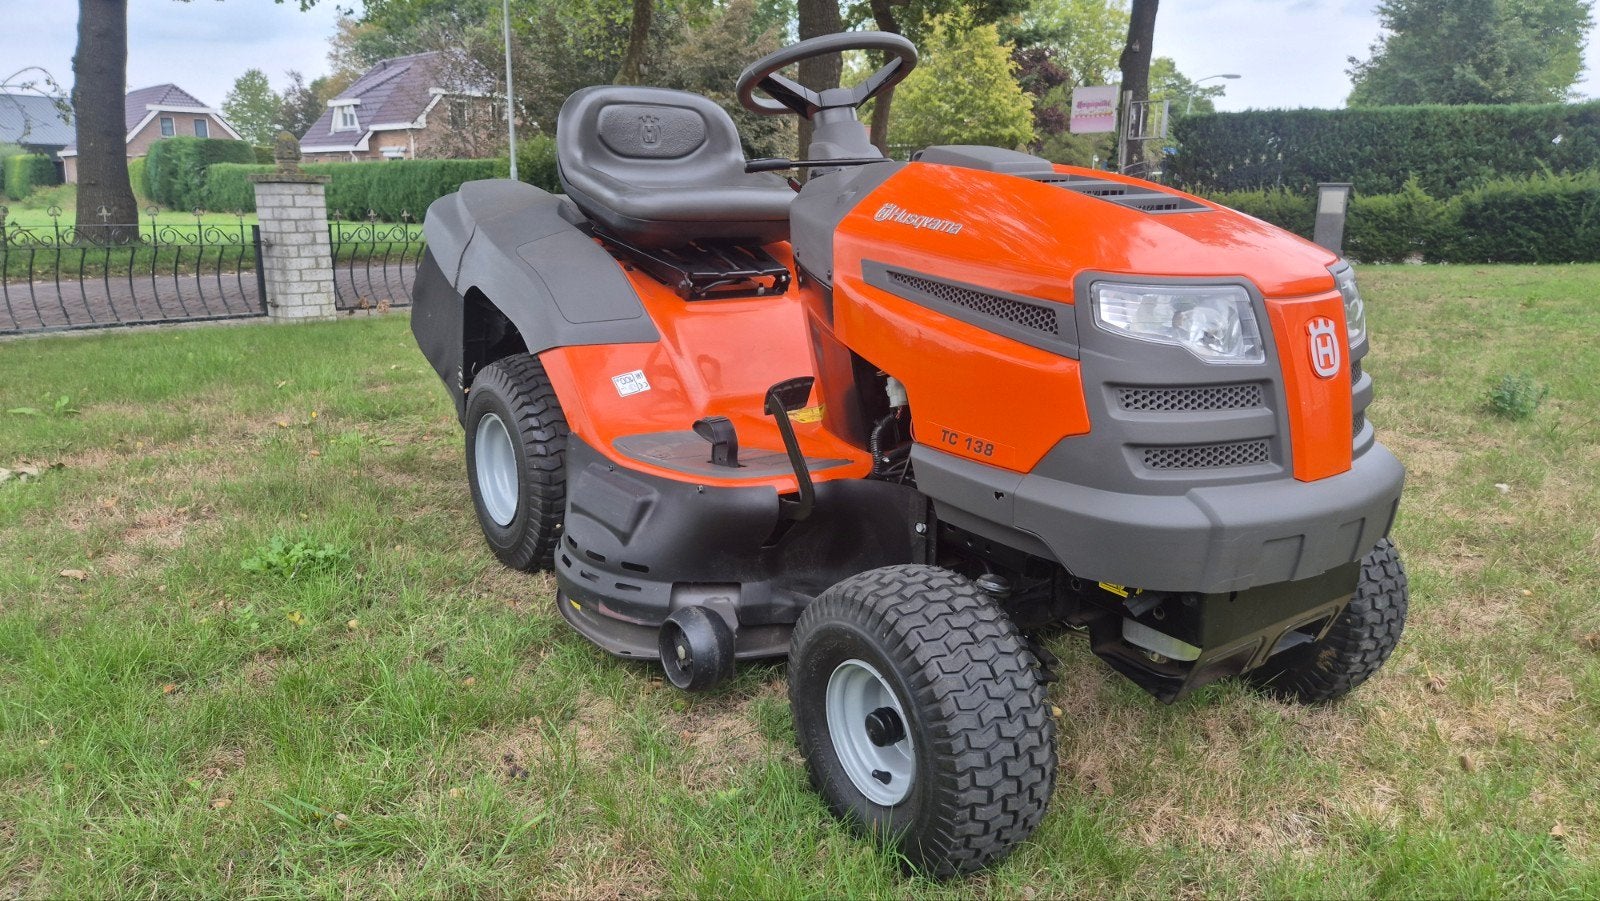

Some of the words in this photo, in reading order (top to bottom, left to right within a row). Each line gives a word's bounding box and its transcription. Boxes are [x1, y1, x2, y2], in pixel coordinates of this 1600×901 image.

[889, 207, 963, 235] Husqvarna
[942, 429, 959, 446] TC
[965, 436, 995, 457] 138
